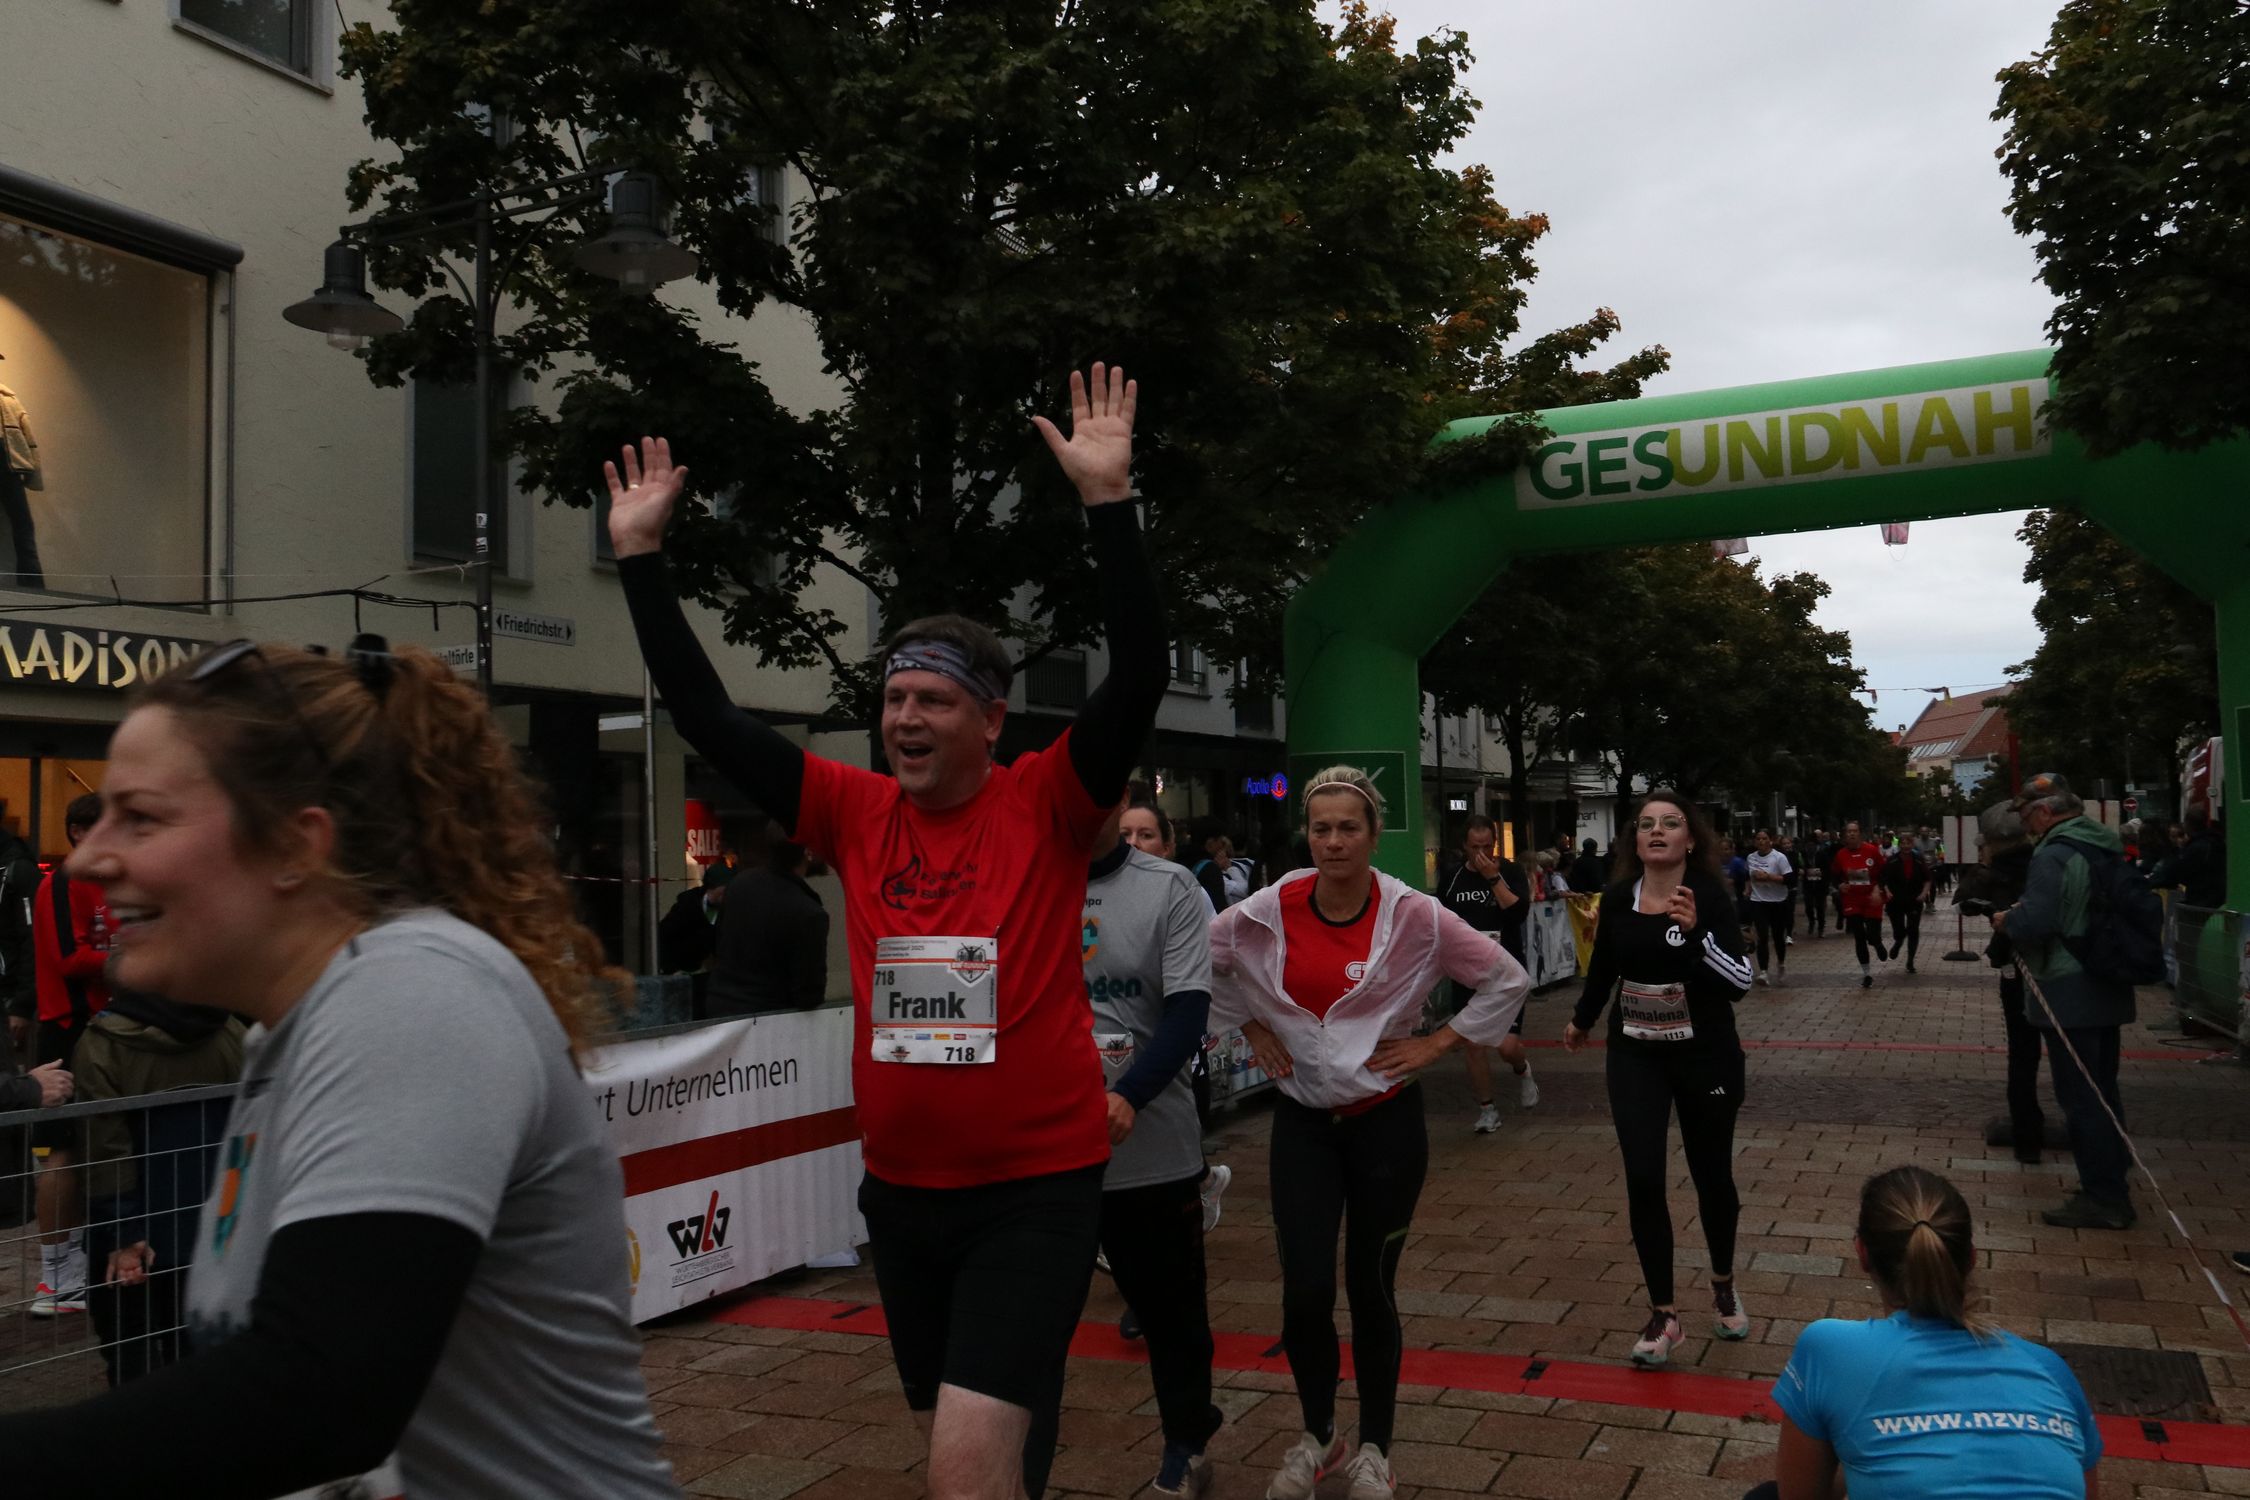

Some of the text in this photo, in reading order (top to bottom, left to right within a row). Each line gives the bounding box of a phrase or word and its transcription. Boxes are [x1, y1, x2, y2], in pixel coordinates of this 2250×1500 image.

[1529, 387, 2034, 500] GESUNDNAH
[504, 614, 565, 638] Friedrichstr.
[687, 829, 721, 856] SALE
[1456, 890, 1490, 903] mey
[875, 970, 895, 985] 718
[889, 992, 966, 1018] Frank
[1623, 1006, 1684, 1022] Annalena
[1664, 1031, 1685, 1040] 1113
[945, 1047, 975, 1061] 718
[627, 1058, 797, 1116] Unternehmen
[1872, 1411, 2075, 1438] www.nzvs.de
